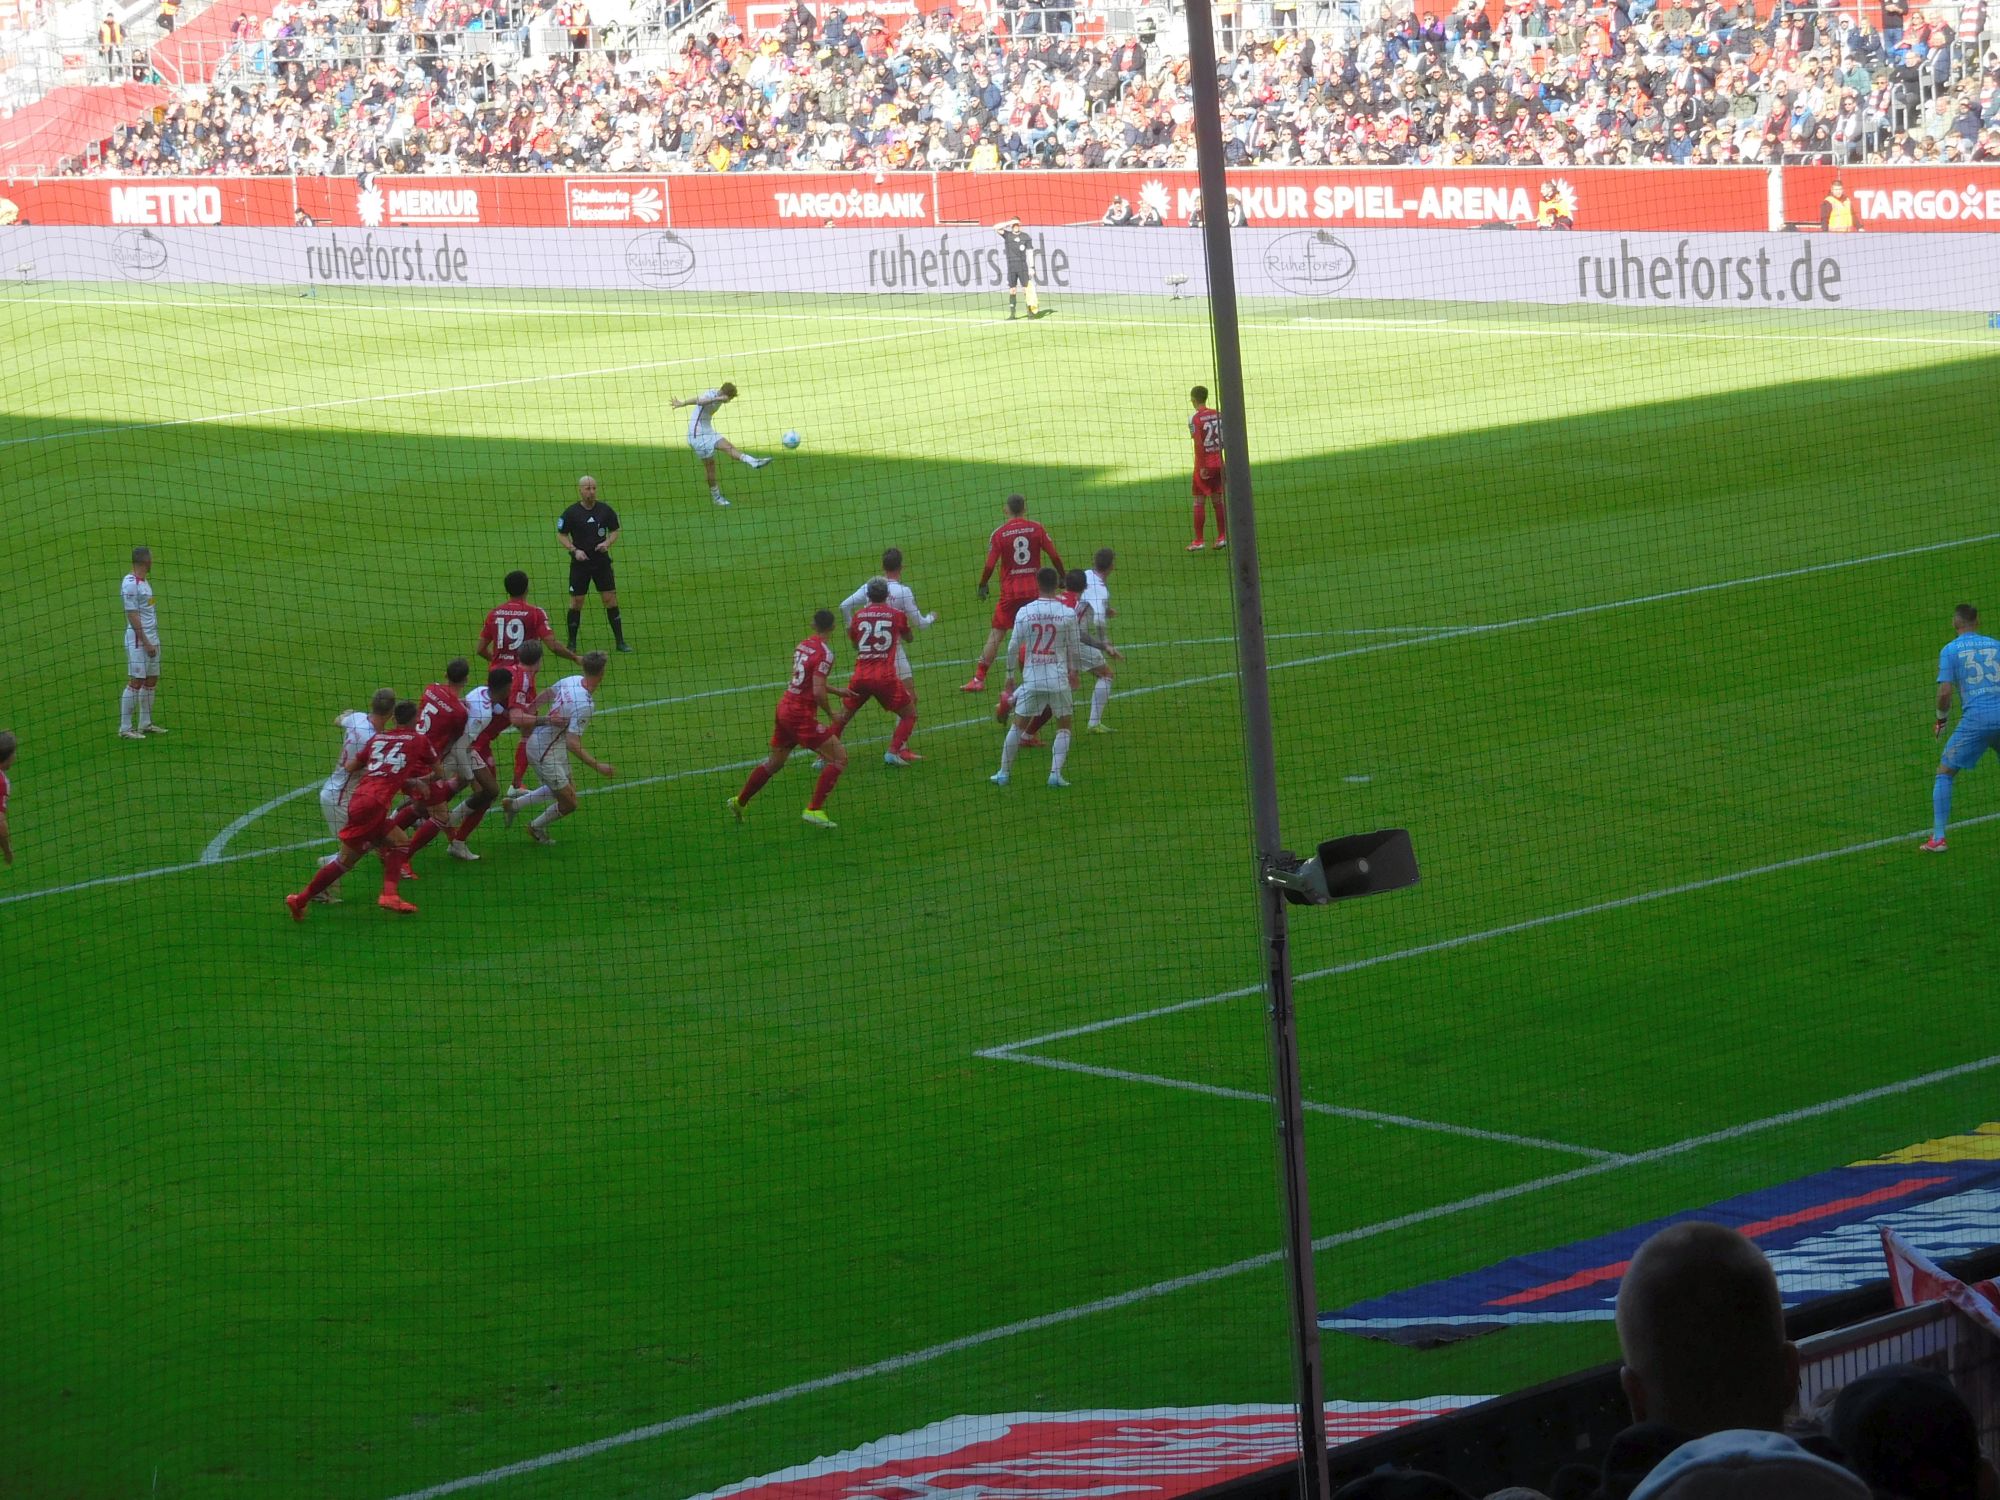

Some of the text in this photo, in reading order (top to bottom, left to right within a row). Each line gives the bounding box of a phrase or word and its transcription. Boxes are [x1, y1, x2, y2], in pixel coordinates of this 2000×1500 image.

[111, 186, 221, 224] METRO
[389, 190, 479, 216] MERKUR
[1177, 186, 1534, 220] MKUR SPIEL-ARENA
[307, 232, 468, 281] ruheforst.de
[869, 232, 1070, 288] ruheforsde
[1578, 238, 1842, 302] ruheforst.de
[1013, 536, 1031, 566] 8
[495, 618, 525, 651] 19
[858, 620, 893, 652] 25
[1031, 623, 1057, 655] 22
[1958, 648, 2000, 685] 33
[415, 702, 439, 735] 5
[368, 741, 407, 774] 34
